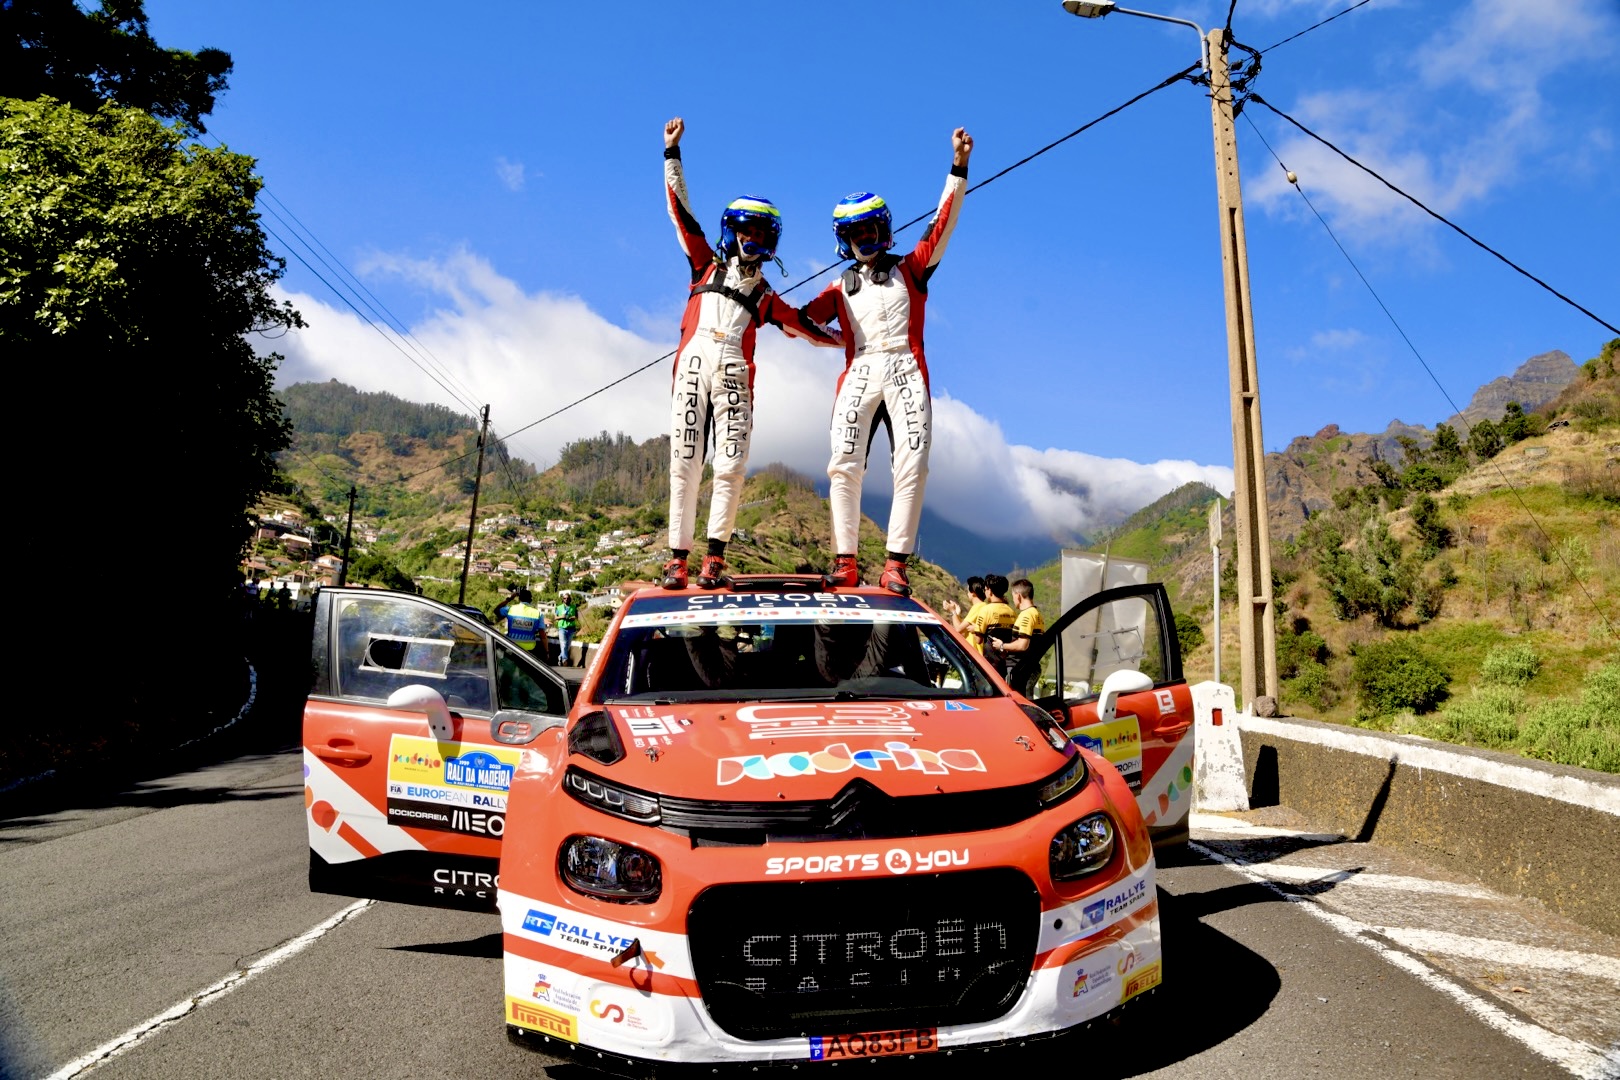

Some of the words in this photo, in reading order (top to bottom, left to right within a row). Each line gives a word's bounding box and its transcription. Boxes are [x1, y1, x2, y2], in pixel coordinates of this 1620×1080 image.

[688, 592, 866, 604] CITROËN
[446, 762, 464, 782] RALI
[466, 767, 476, 784] DA
[477, 768, 511, 788] MADEIRA
[407, 786, 468, 804] EUROPEAN
[388, 807, 449, 822] SOCICORREIA
[451, 810, 505, 836] MEO
[765, 853, 879, 875] SPORTS
[886, 849, 910, 873] &
[916, 848, 969, 871] YOU
[1106, 879, 1146, 910] RALLYE
[1110, 902, 1128, 916] TEAM
[1129, 891, 1145, 906] SPAIN
[555, 920, 634, 948] RALLYE
[559, 933, 591, 947] TEAM
[1125, 965, 1159, 997] PIRELLI
[512, 1001, 571, 1037] PIRELLI
[814, 1048, 821, 1057] P
[827, 1028, 934, 1058] AQ83FB
